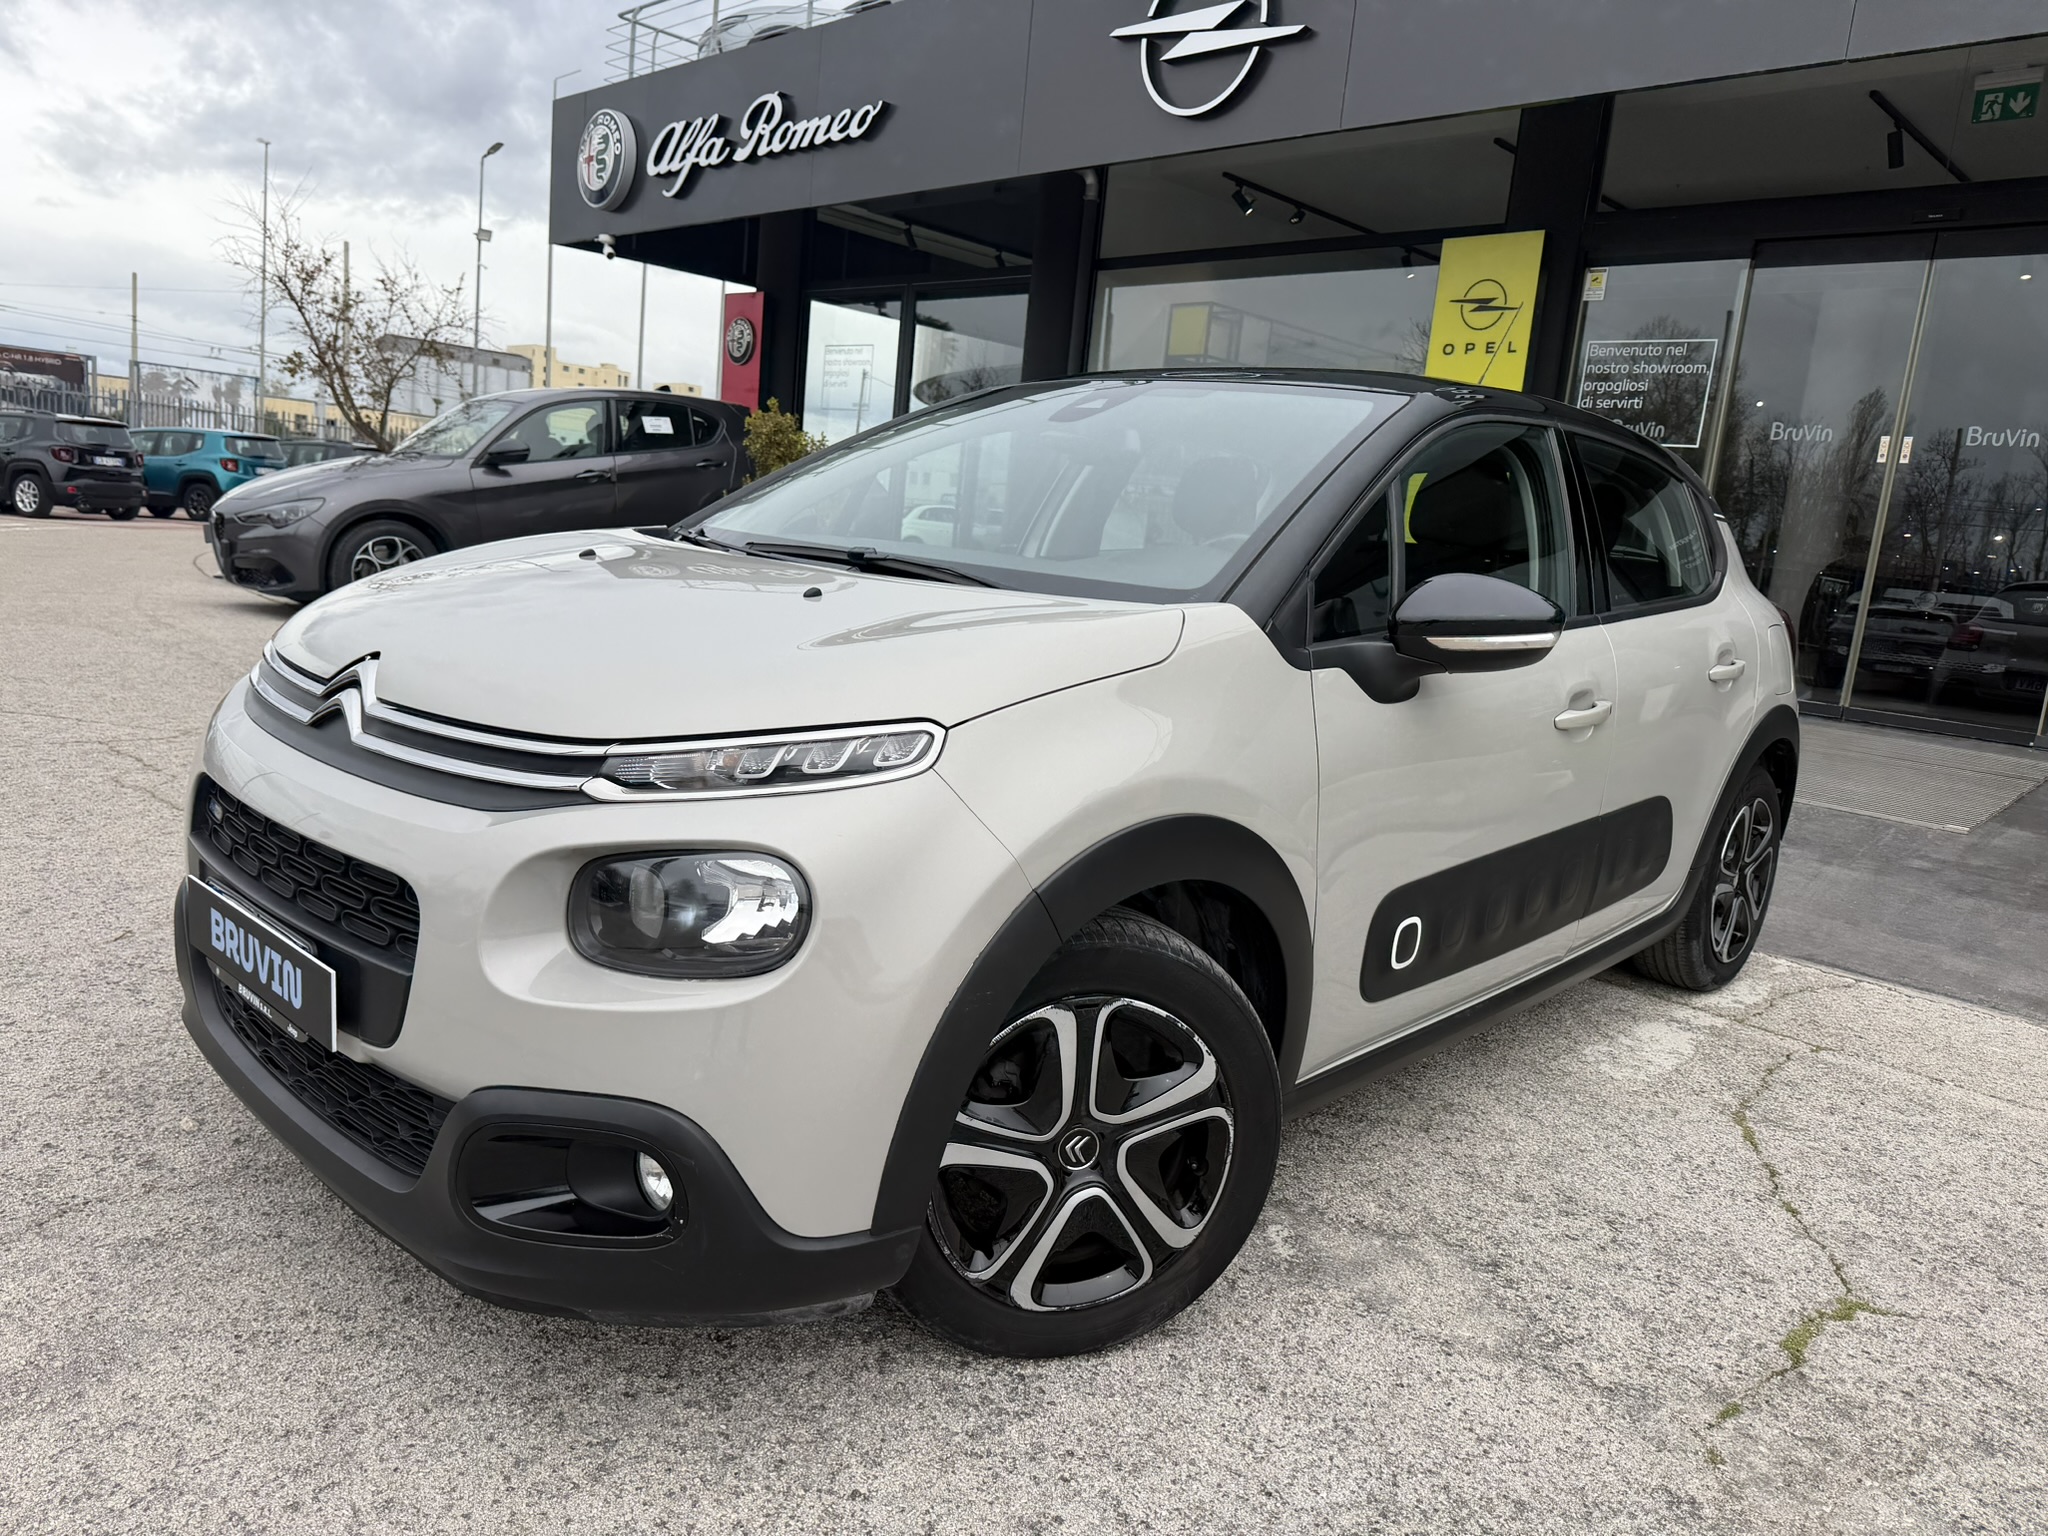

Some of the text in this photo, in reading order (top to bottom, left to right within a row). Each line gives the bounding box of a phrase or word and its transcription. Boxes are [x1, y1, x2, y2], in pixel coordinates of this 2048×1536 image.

[646, 91, 883, 198] Alfa Romeo
[1442, 341, 1517, 356] OPEL
[1589, 343, 1688, 357] Benvenuto nel
[1587, 361, 1710, 375] nostro showroom,
[1583, 379, 1649, 394] orgogliosi
[1580, 396, 1643, 409] di servirti
[1770, 421, 1833, 442] BruVin
[1965, 425, 2041, 448] BruVin
[210, 907, 302, 1010] BRUVIN
